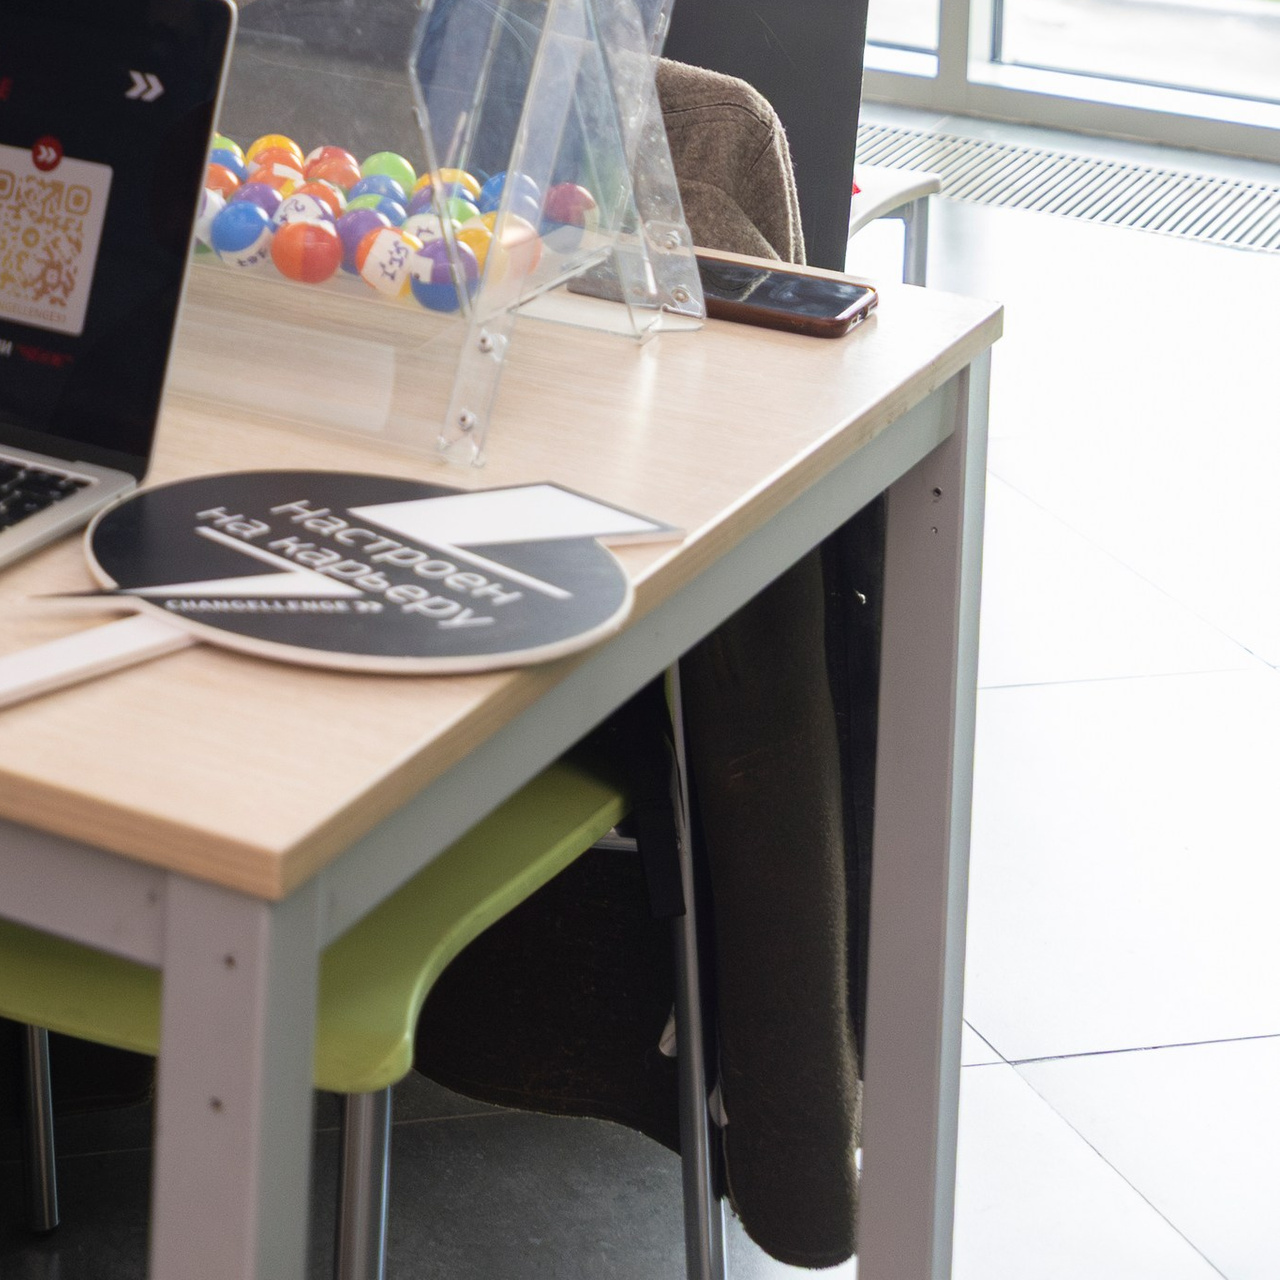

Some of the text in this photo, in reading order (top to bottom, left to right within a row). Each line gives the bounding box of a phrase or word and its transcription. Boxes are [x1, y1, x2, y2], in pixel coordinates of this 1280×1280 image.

[268, 535, 496, 630] карьеру
[269, 498, 523, 606] Настроен
[163, 598, 351, 613] CHANGELLENGE
